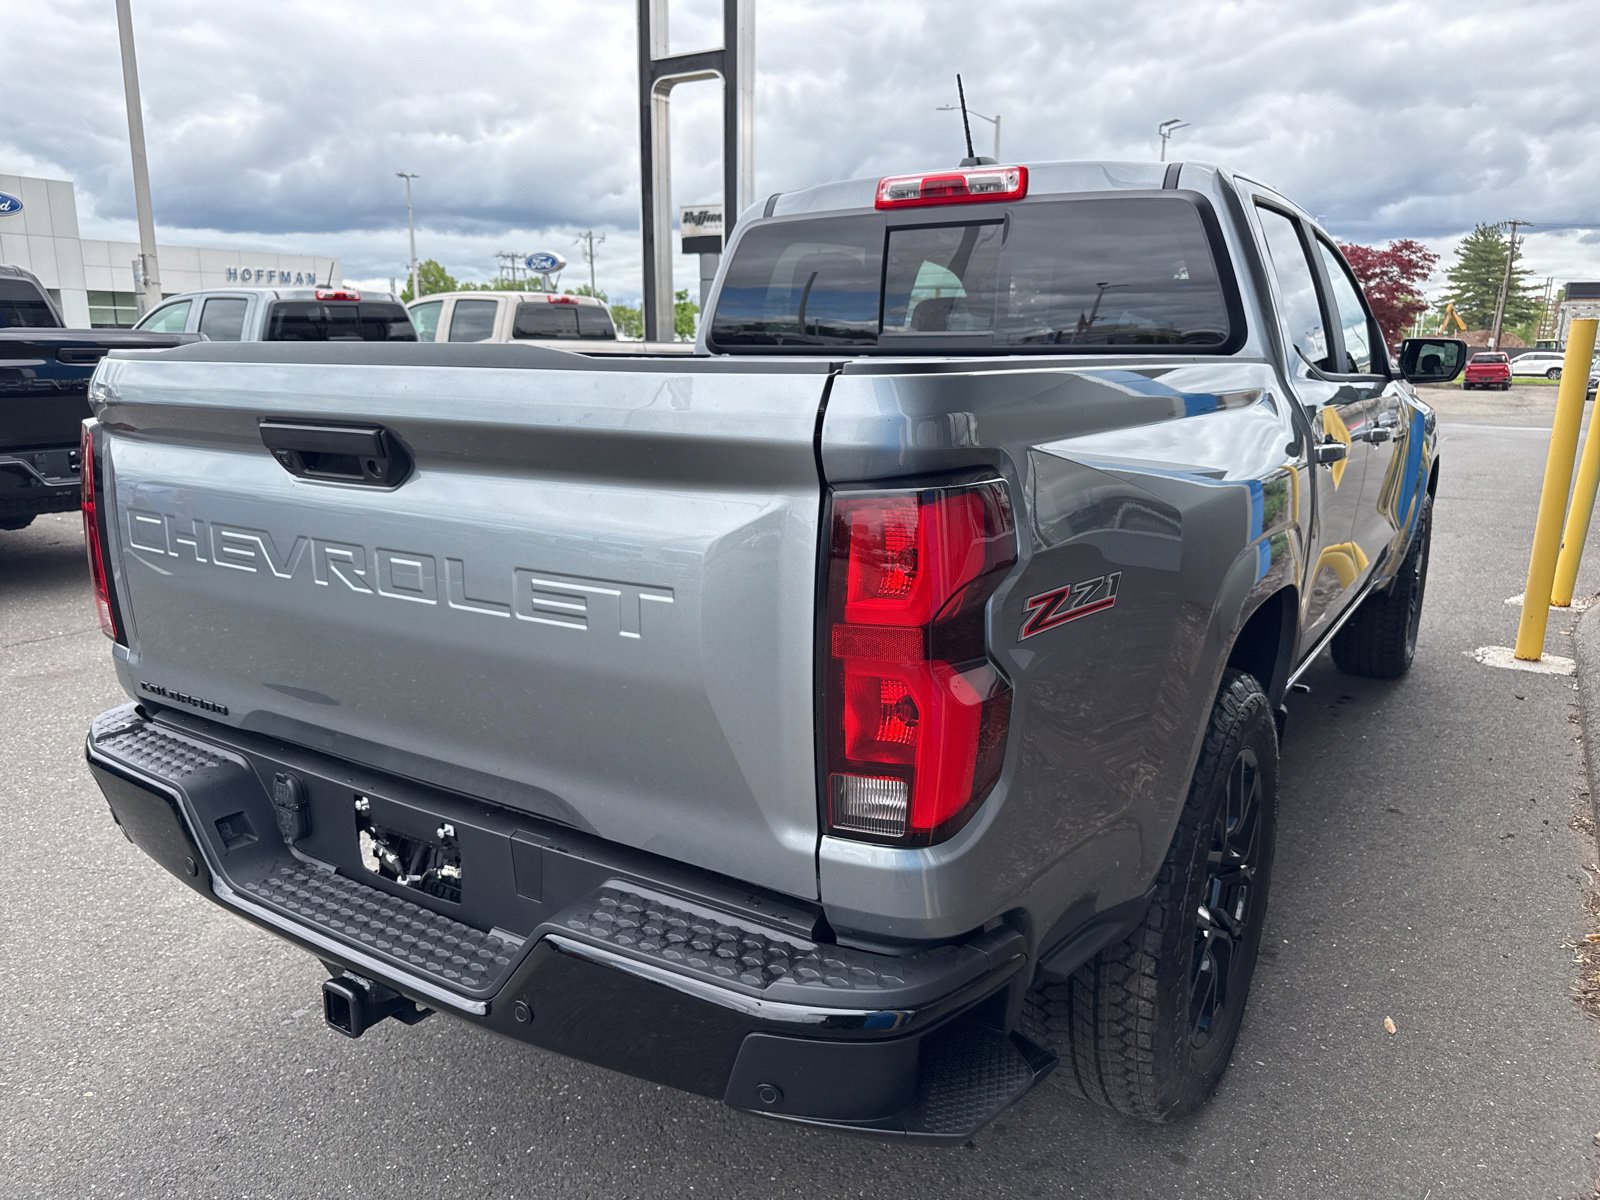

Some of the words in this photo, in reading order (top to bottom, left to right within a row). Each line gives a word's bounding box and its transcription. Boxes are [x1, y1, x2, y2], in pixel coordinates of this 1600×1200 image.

[226, 266, 317, 285] HOFFMAN
[531, 256, 554, 270] Ford
[126, 506, 676, 639] CHEVROLET
[1016, 569, 1122, 643] Z71
